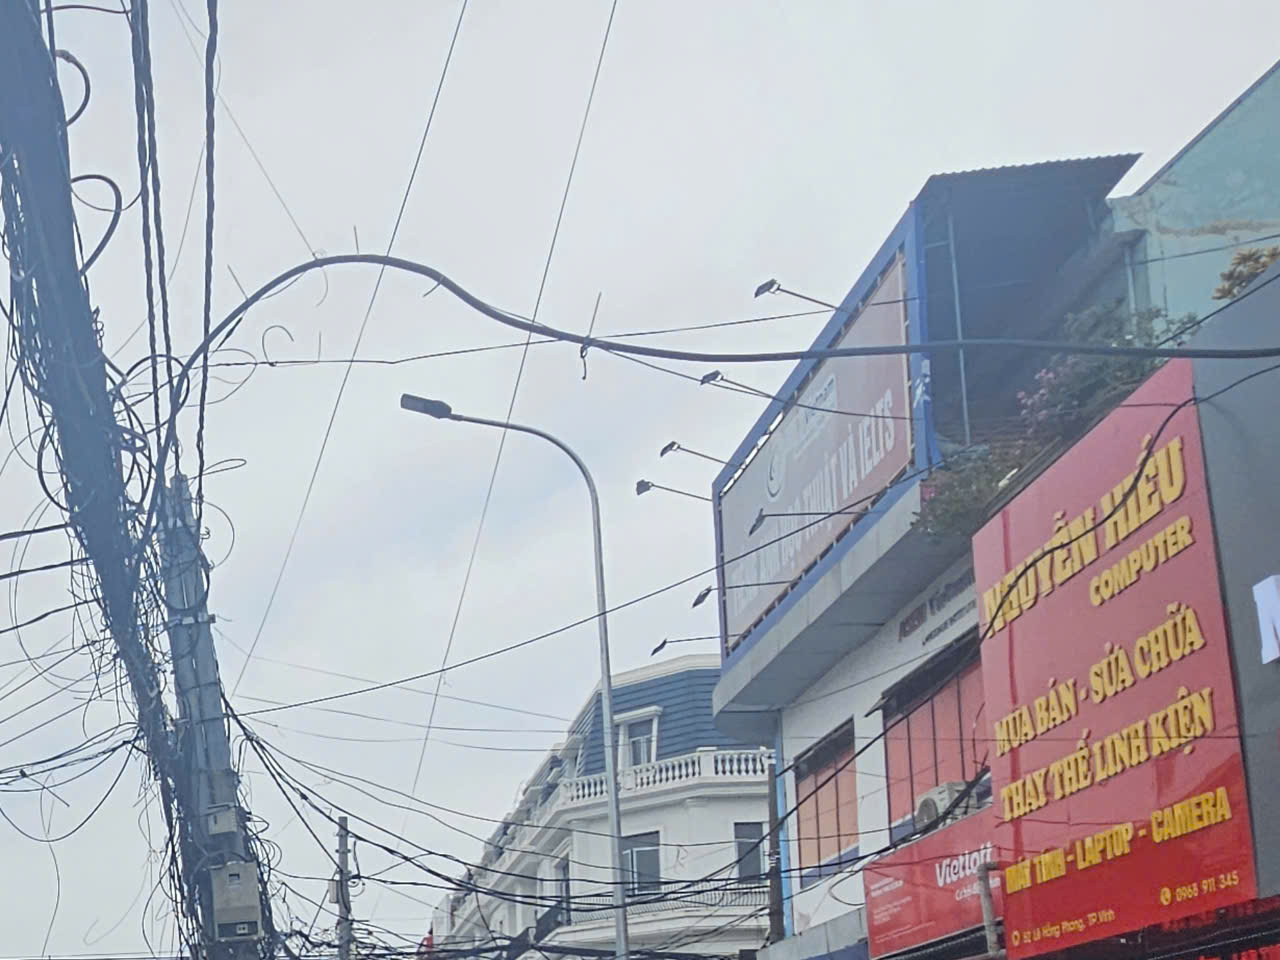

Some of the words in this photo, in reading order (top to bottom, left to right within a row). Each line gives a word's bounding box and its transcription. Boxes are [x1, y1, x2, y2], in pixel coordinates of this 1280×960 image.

[802, 453, 838, 537] THUẬT
[839, 424, 858, 500] VÀ
[859, 388, 895, 479] IELTS
[983, 510, 1100, 639] NGUYỄN
[1100, 433, 1186, 551] HIẾU
[1089, 515, 1196, 606] COMPUTER
[994, 704, 1037, 758] MUA
[1034, 677, 1079, 736] BÁN
[1089, 641, 1137, 704] SỬA
[1134, 601, 1207, 679] CHỮA
[1000, 767, 1049, 822] THAY
[1050, 728, 1094, 801] THẾ
[1093, 720, 1150, 782] LINH
[1148, 686, 1216, 757] KIỆN
[935, 841, 993, 888] Vietlott
[1033, 848, 1067, 885] TÍNH
[1075, 822, 1135, 870] LAPTOP
[1151, 787, 1232, 843] CAMERA
[1201, 878, 1216, 896] 911
[1218, 869, 1240, 890] 345
